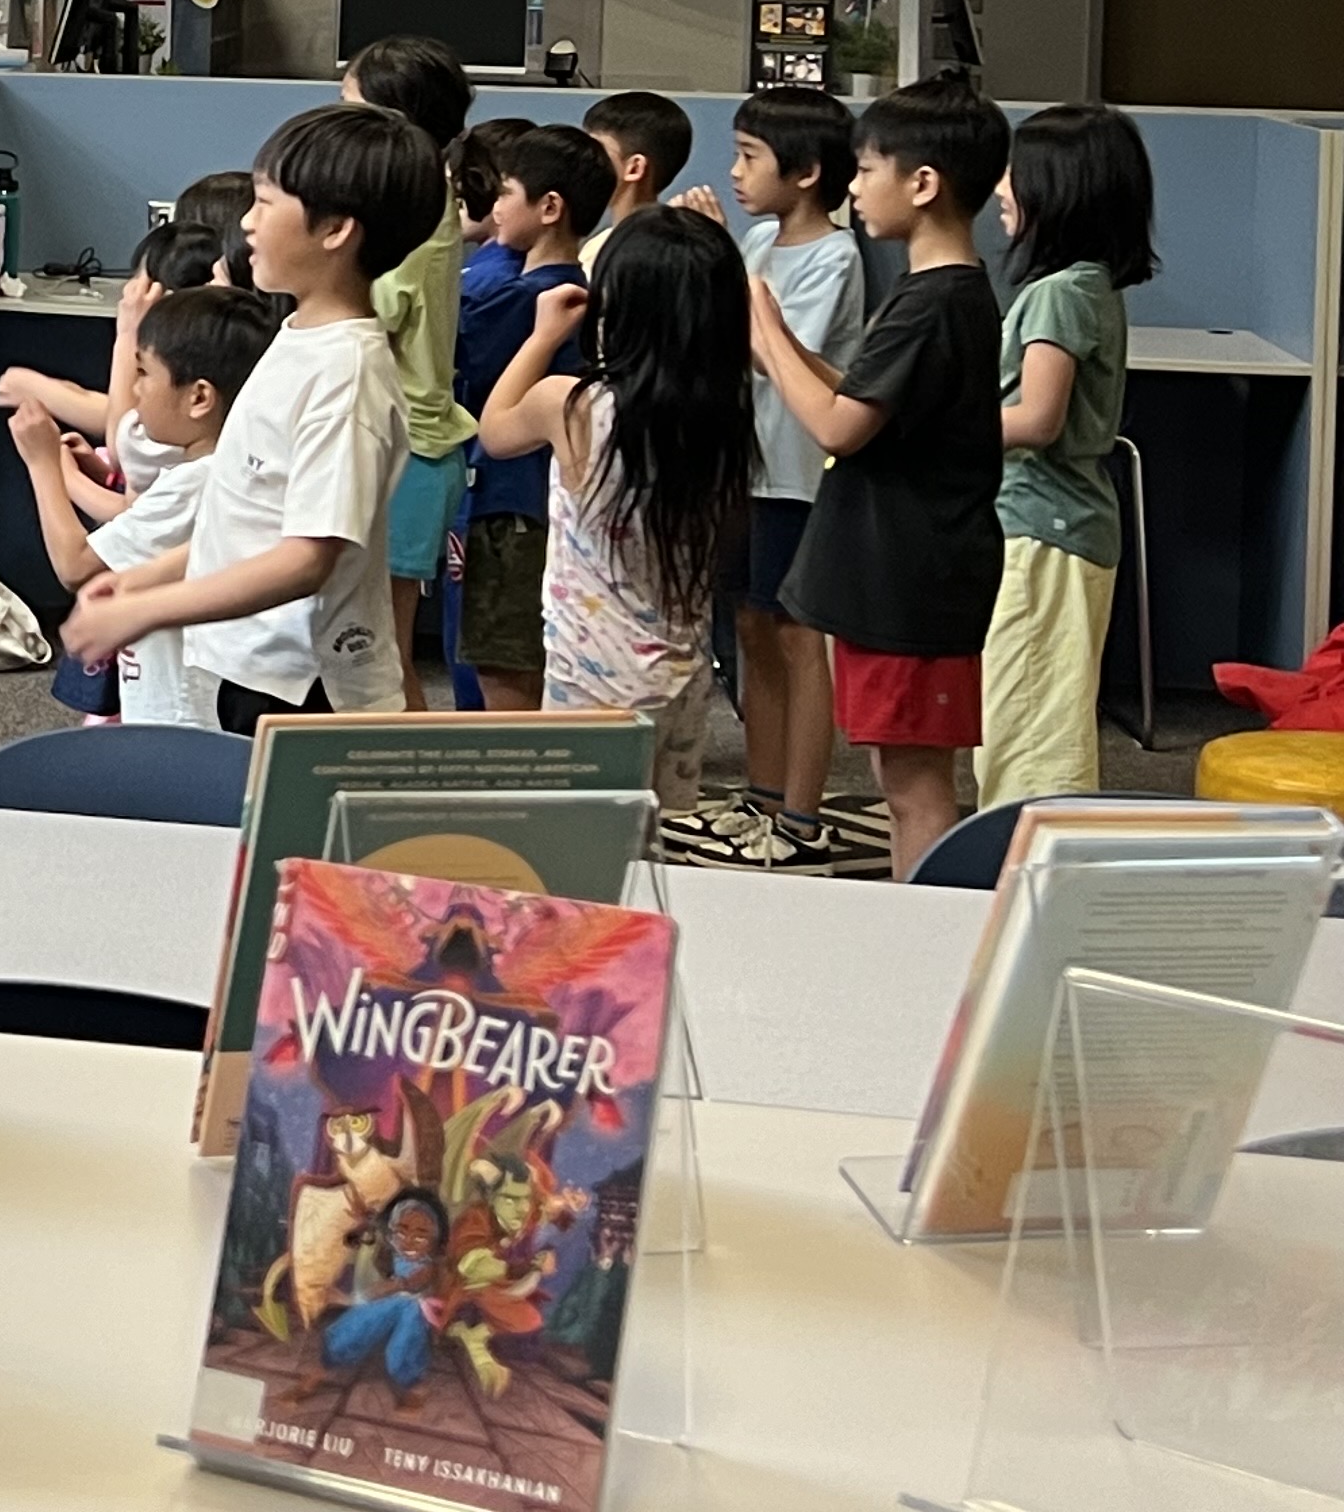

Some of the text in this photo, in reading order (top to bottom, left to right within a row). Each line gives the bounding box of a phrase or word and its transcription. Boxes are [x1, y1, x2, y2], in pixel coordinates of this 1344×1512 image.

[323, 1431, 355, 1458] LIU
[384, 1447, 563, 1504] TENY ISSAKHANIAN
